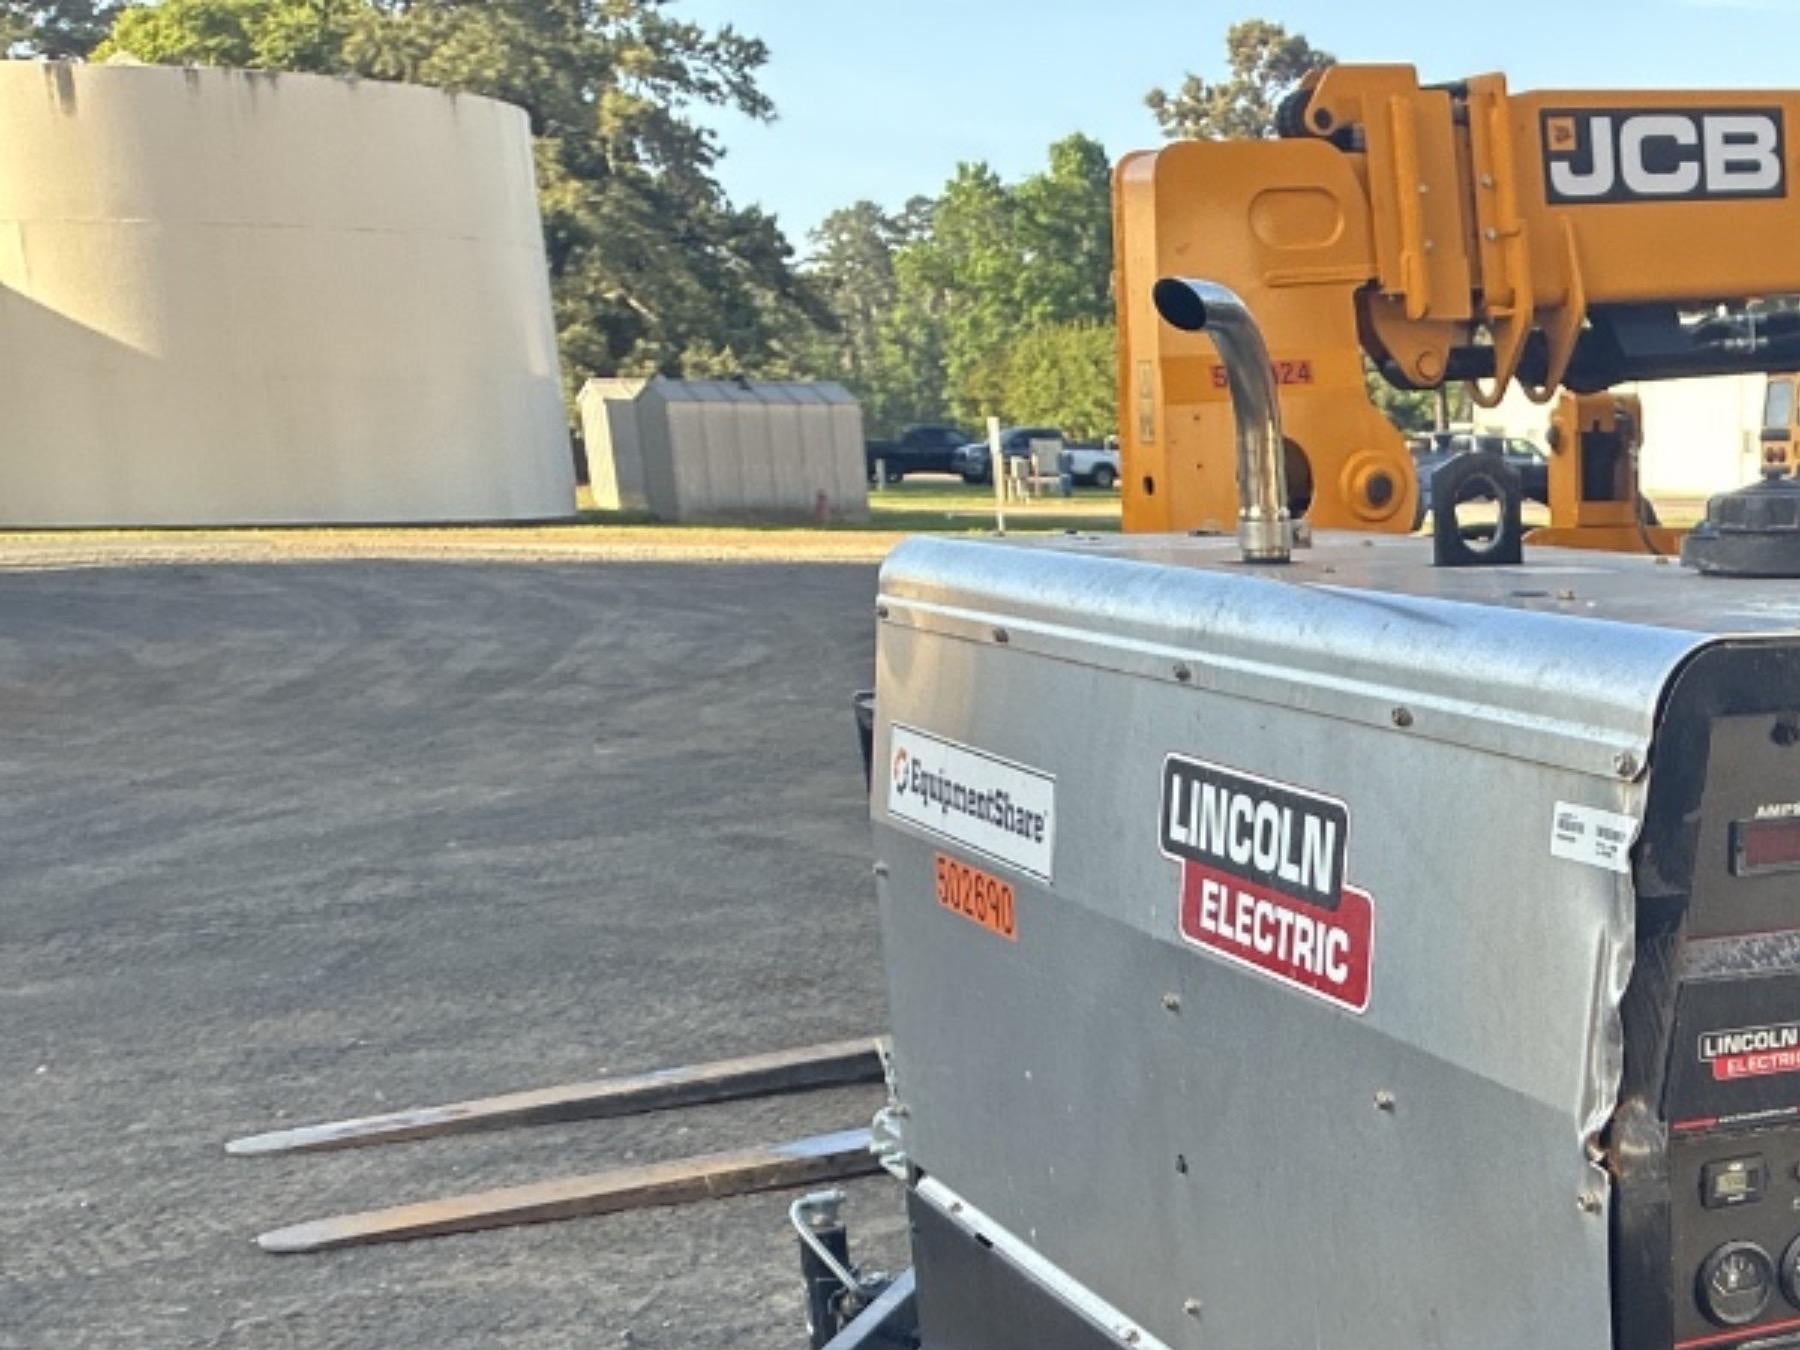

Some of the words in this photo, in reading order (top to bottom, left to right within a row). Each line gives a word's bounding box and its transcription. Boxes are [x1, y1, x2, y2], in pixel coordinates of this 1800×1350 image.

[1550, 115, 1782, 197] JCB
[909, 757, 1047, 844] EquipmentShare
[1168, 772, 1337, 896] LINCOLN
[936, 858, 1015, 937] 502690
[1200, 880, 1351, 985] ELECTRIC
[1704, 1027, 1799, 1057] LINCOLN
